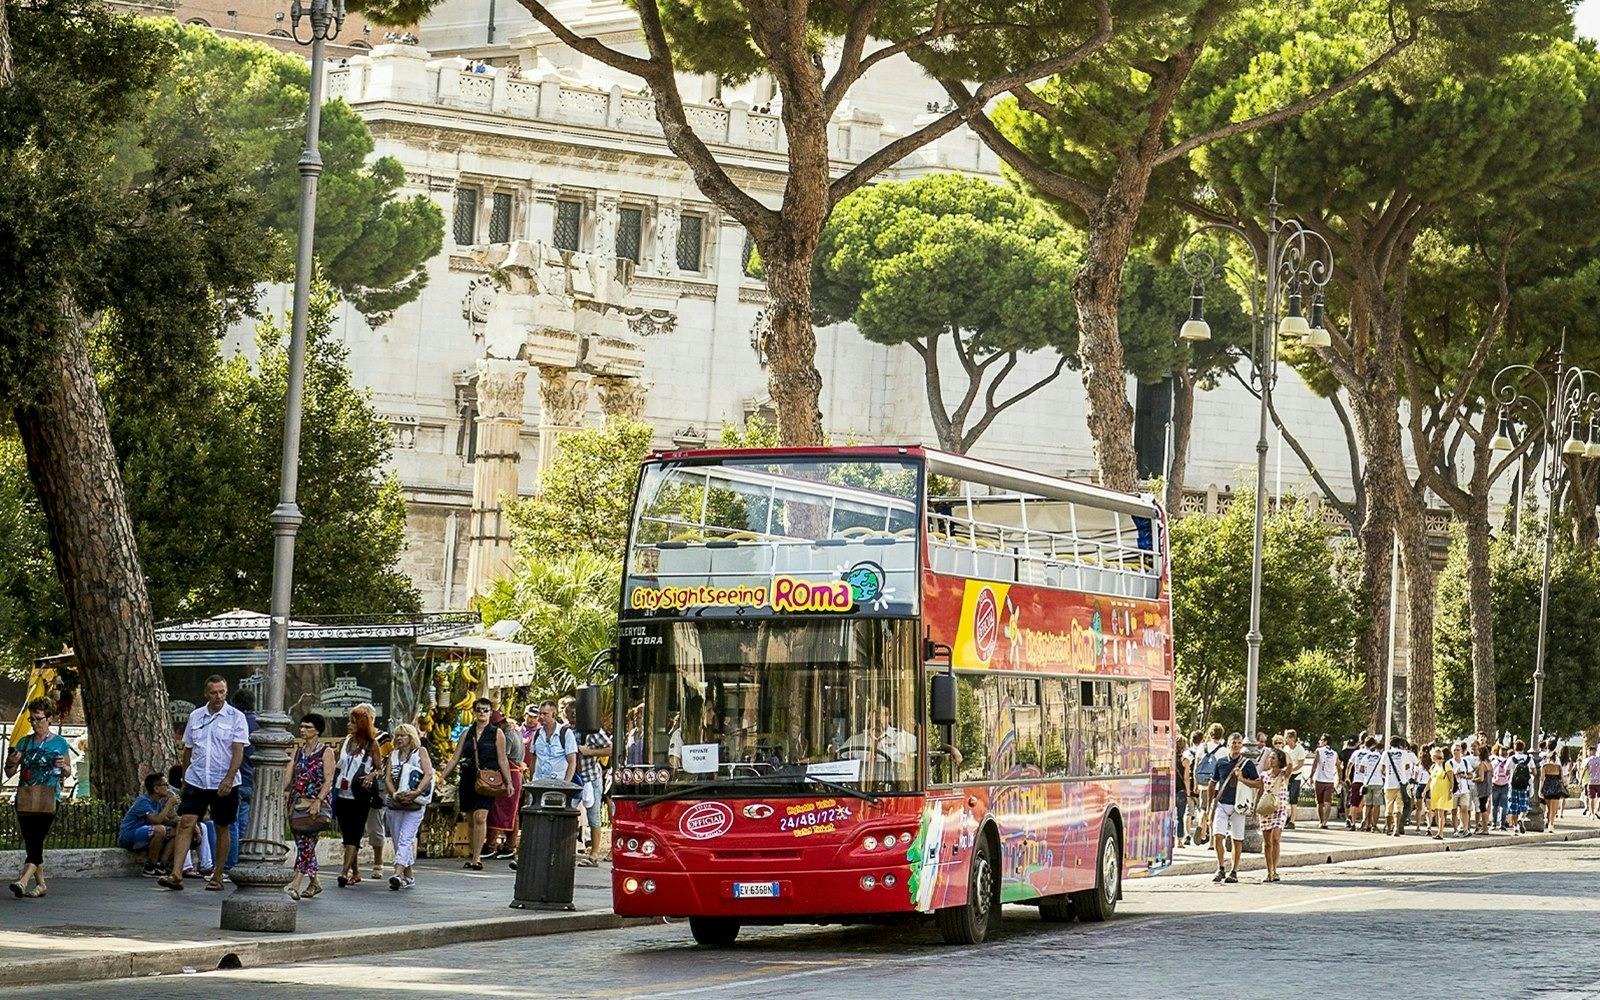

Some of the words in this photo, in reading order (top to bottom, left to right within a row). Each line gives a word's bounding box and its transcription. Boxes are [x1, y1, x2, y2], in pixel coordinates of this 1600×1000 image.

[632, 585, 767, 609] CitySightseeing
[774, 577, 850, 609] Roma
[631, 636, 663, 645] COBRA
[689, 813, 723, 828] OFFICIAL
[780, 809, 835, 831] 24/48/72
